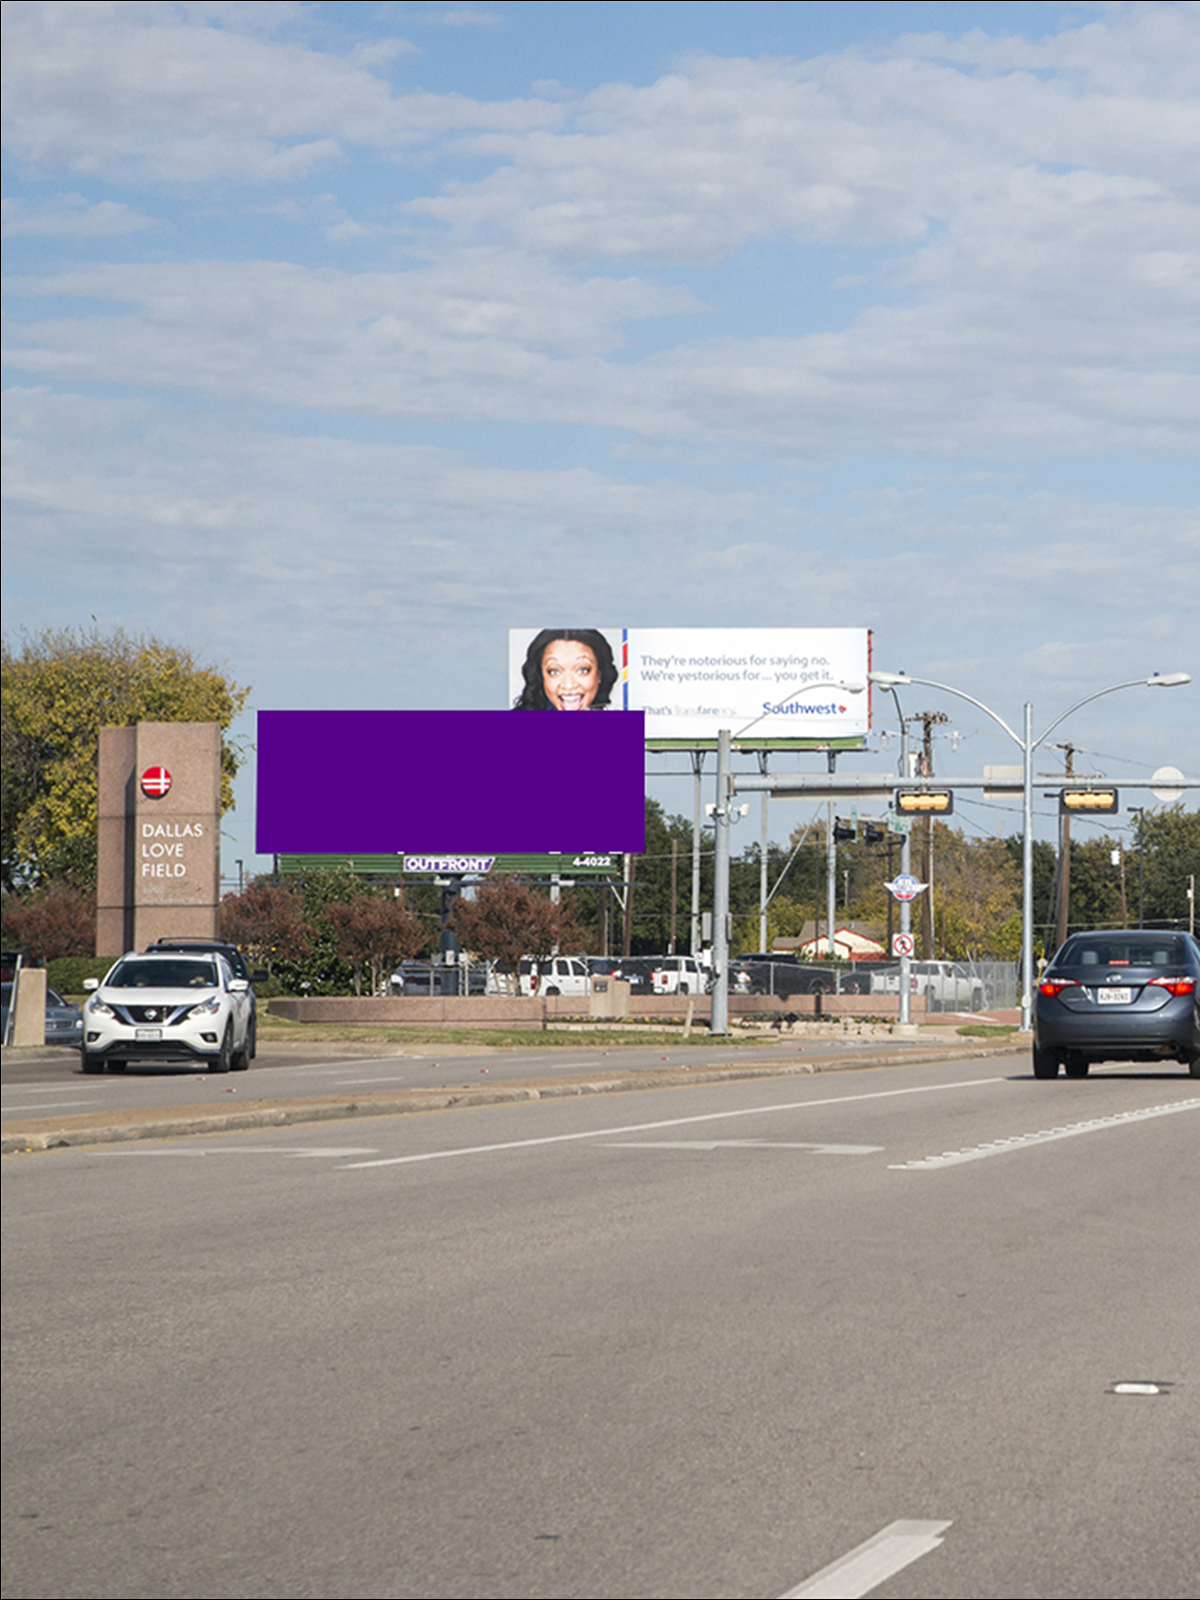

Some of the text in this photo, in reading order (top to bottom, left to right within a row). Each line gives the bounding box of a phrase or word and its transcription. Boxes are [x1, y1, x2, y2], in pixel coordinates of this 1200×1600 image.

[641, 655, 830, 669] They're notorious for saying no.
[641, 670, 675, 681] We're
[678, 669, 740, 683] yestorious
[774, 672, 797, 683] you
[800, 671, 819, 683] get
[822, 669, 834, 681] it.
[642, 705, 672, 716] That's
[762, 701, 836, 715] Southwest
[142, 823, 203, 838] DALLAS
[142, 843, 184, 858] LOVE
[407, 858, 490, 870] OUTFRONT
[572, 856, 612, 867] 4-4022
[142, 863, 187, 878] FIELD
